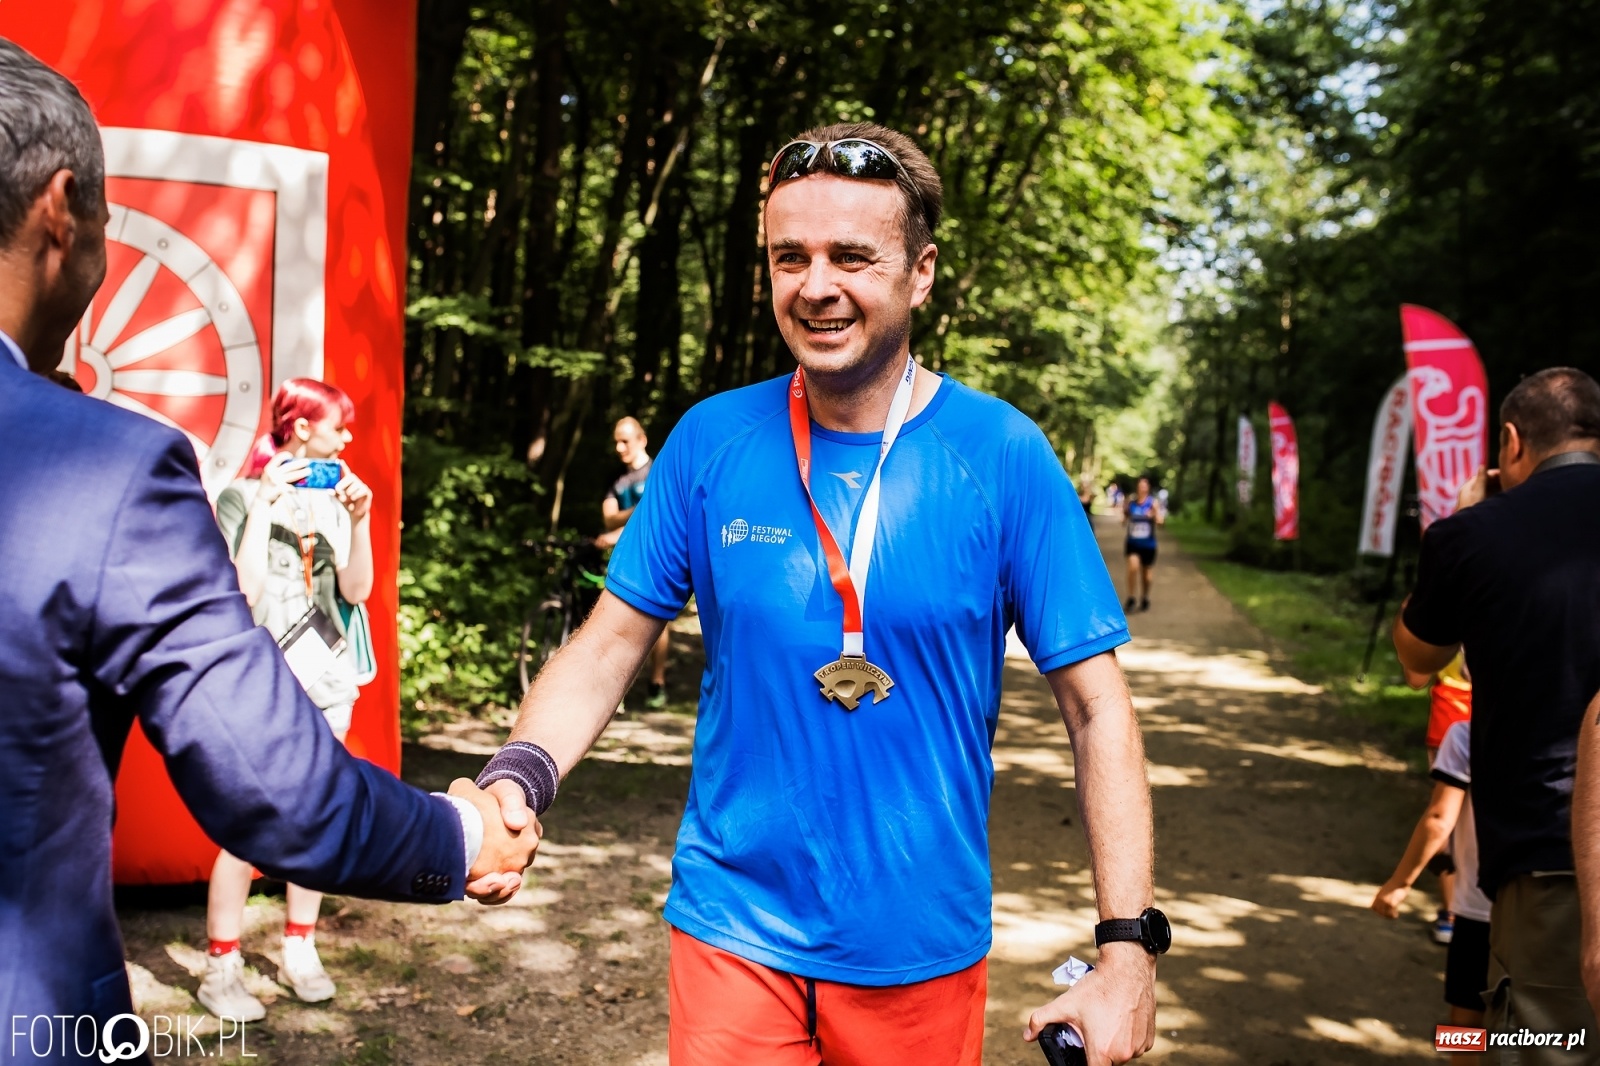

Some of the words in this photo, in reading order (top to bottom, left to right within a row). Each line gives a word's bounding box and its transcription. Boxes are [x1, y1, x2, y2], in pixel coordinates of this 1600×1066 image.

[751, 525, 793, 537] FESTIWAL
[750, 533, 786, 545] BIEGÓW
[818, 662, 855, 679] TROPEM
[856, 662, 890, 687] WILCZYM
